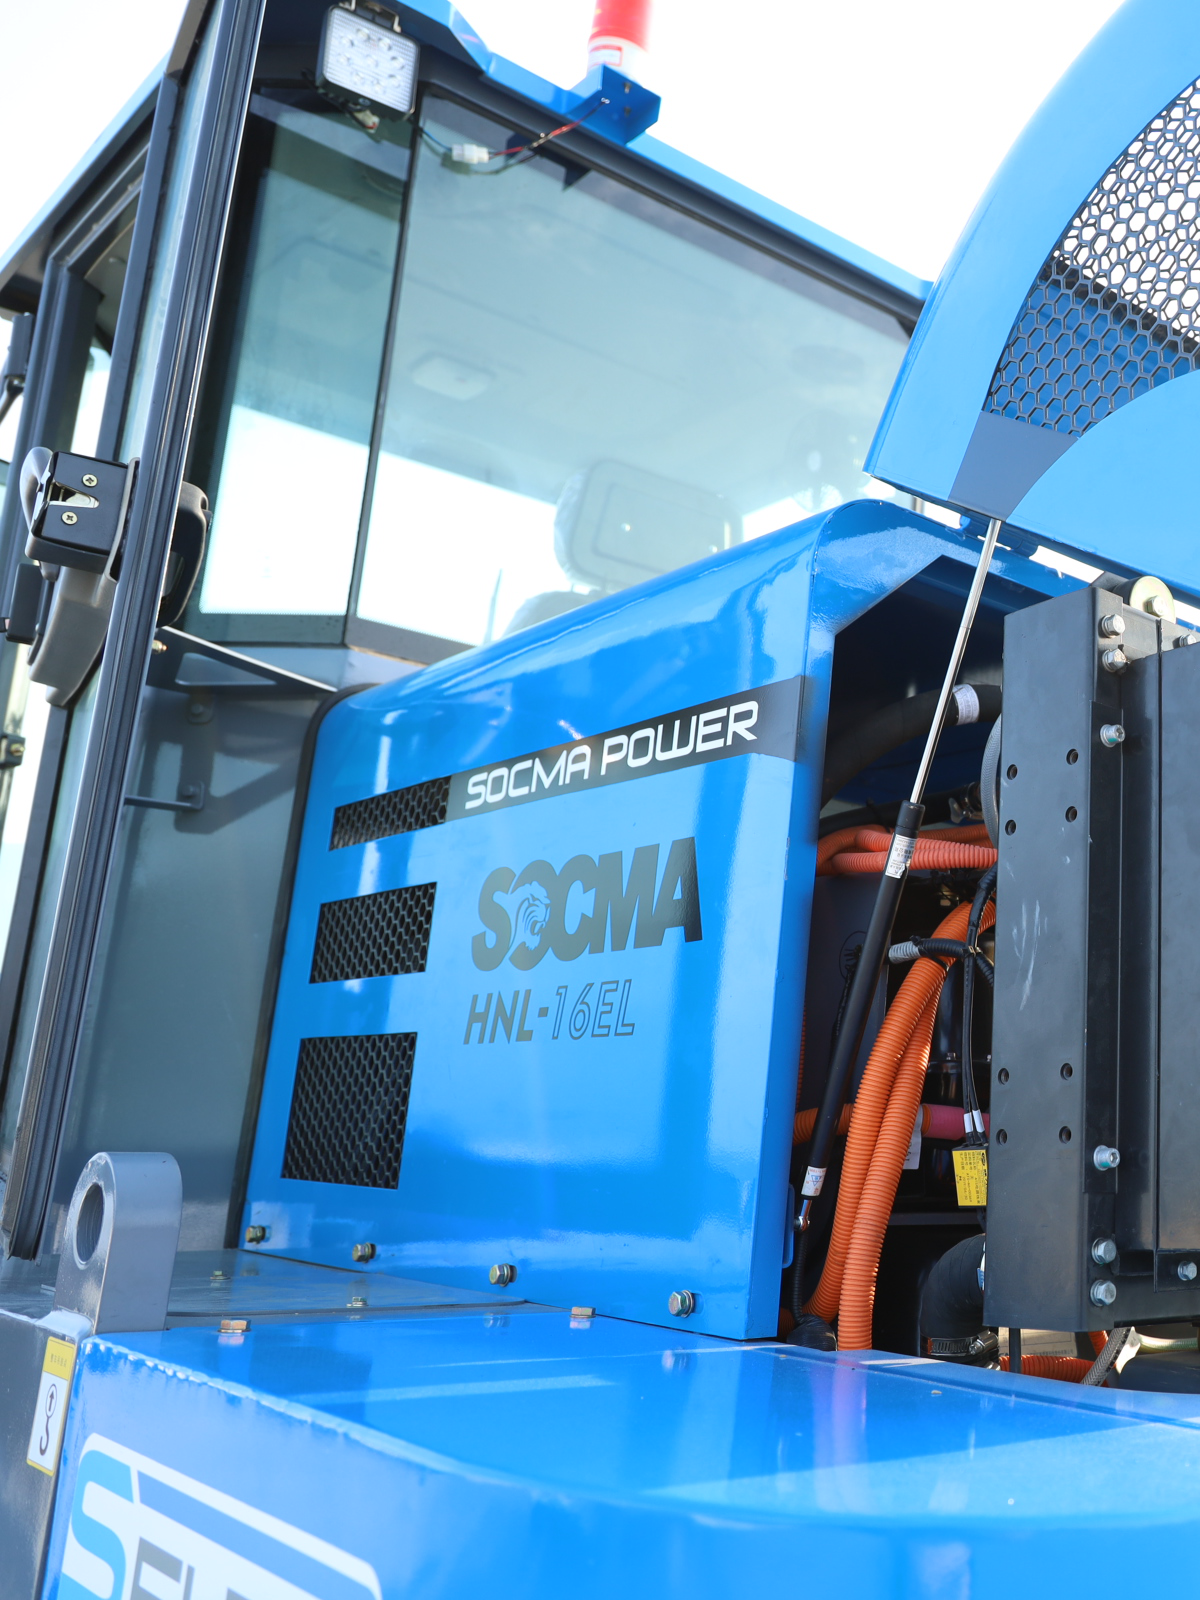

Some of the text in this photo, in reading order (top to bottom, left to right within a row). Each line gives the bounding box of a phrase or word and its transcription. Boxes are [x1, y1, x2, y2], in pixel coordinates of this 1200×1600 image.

[465, 701, 758, 809] SOCMA POWER
[471, 836, 703, 972] SOCMA
[463, 979, 635, 1045] HNL-16EL
